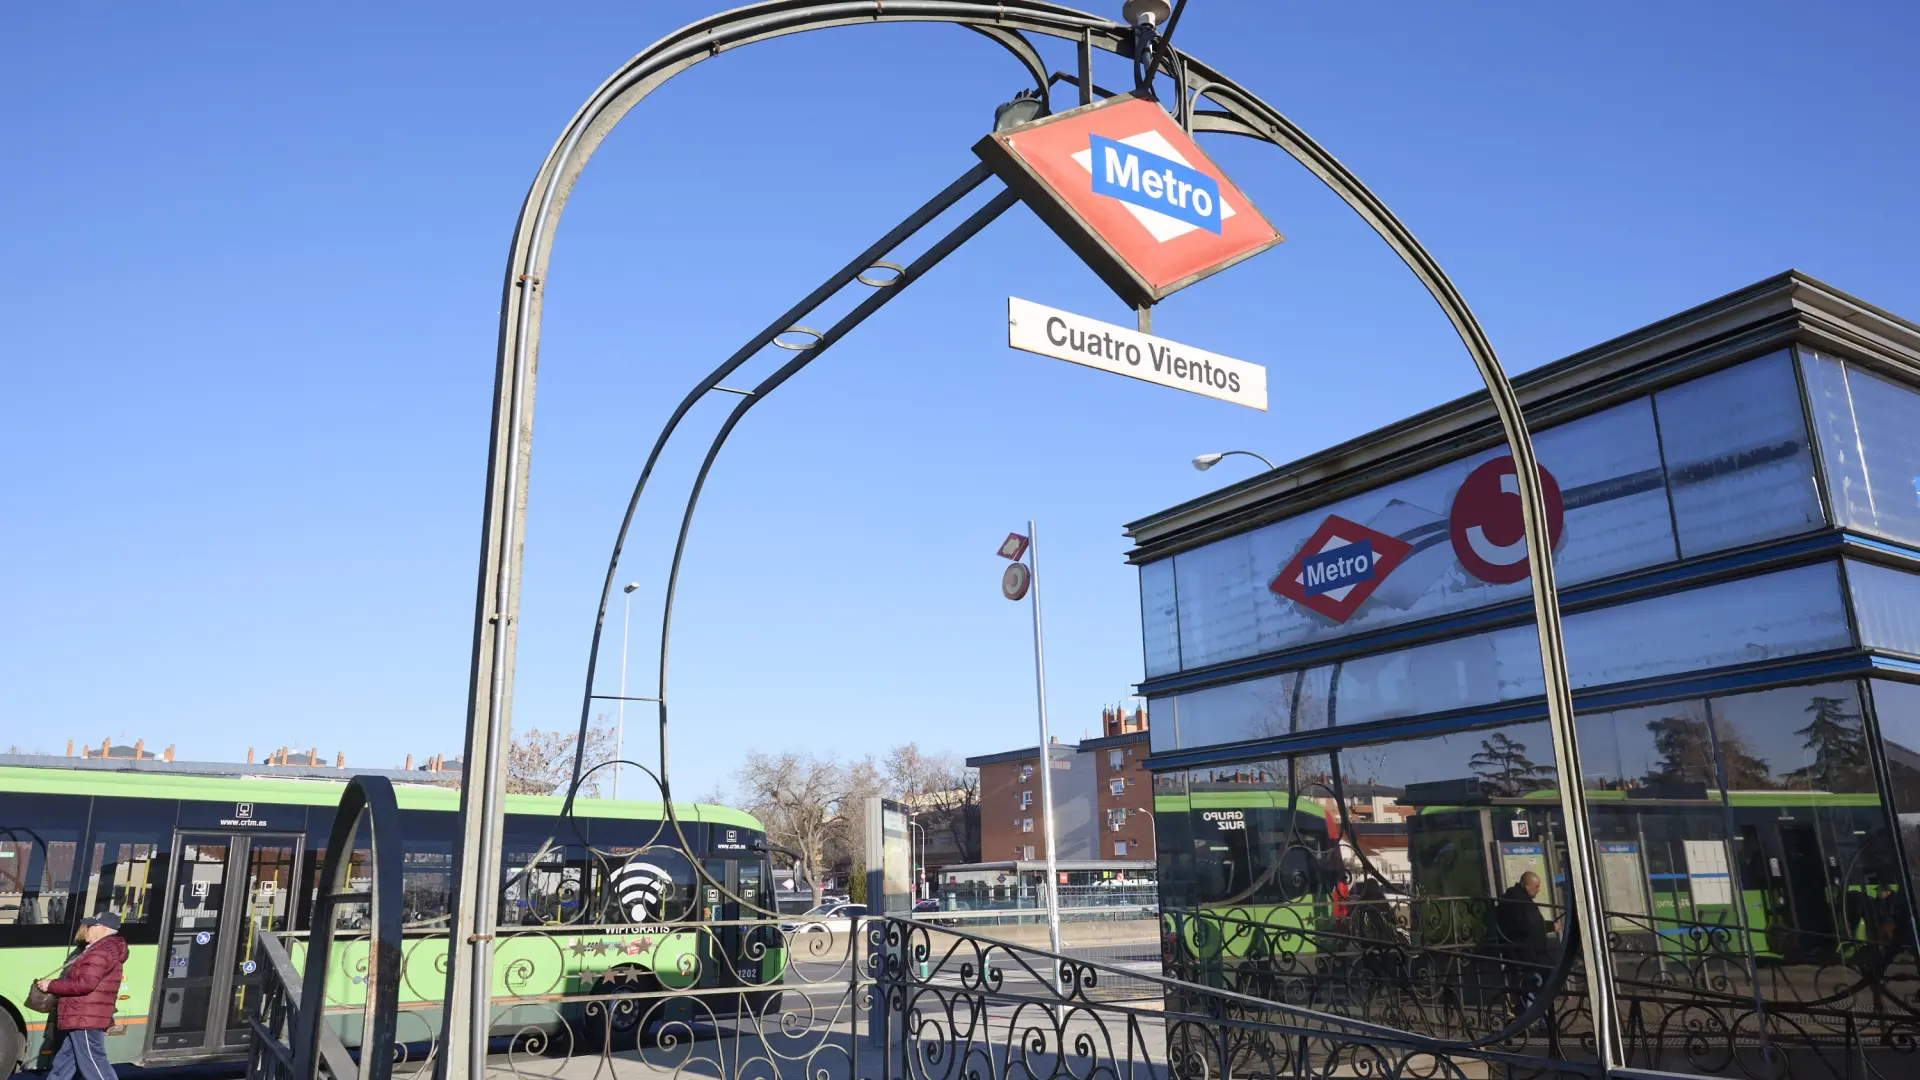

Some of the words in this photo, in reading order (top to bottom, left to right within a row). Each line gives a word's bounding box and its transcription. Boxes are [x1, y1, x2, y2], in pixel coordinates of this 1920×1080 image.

[1104, 146, 1213, 217] Metro
[1046, 316, 1141, 366] Cuatro
[1148, 342, 1241, 393] Vientos
[1306, 555, 1369, 588] Metro
[220, 819, 267, 827] www.crtm.es
[738, 968, 757, 978] 1202
